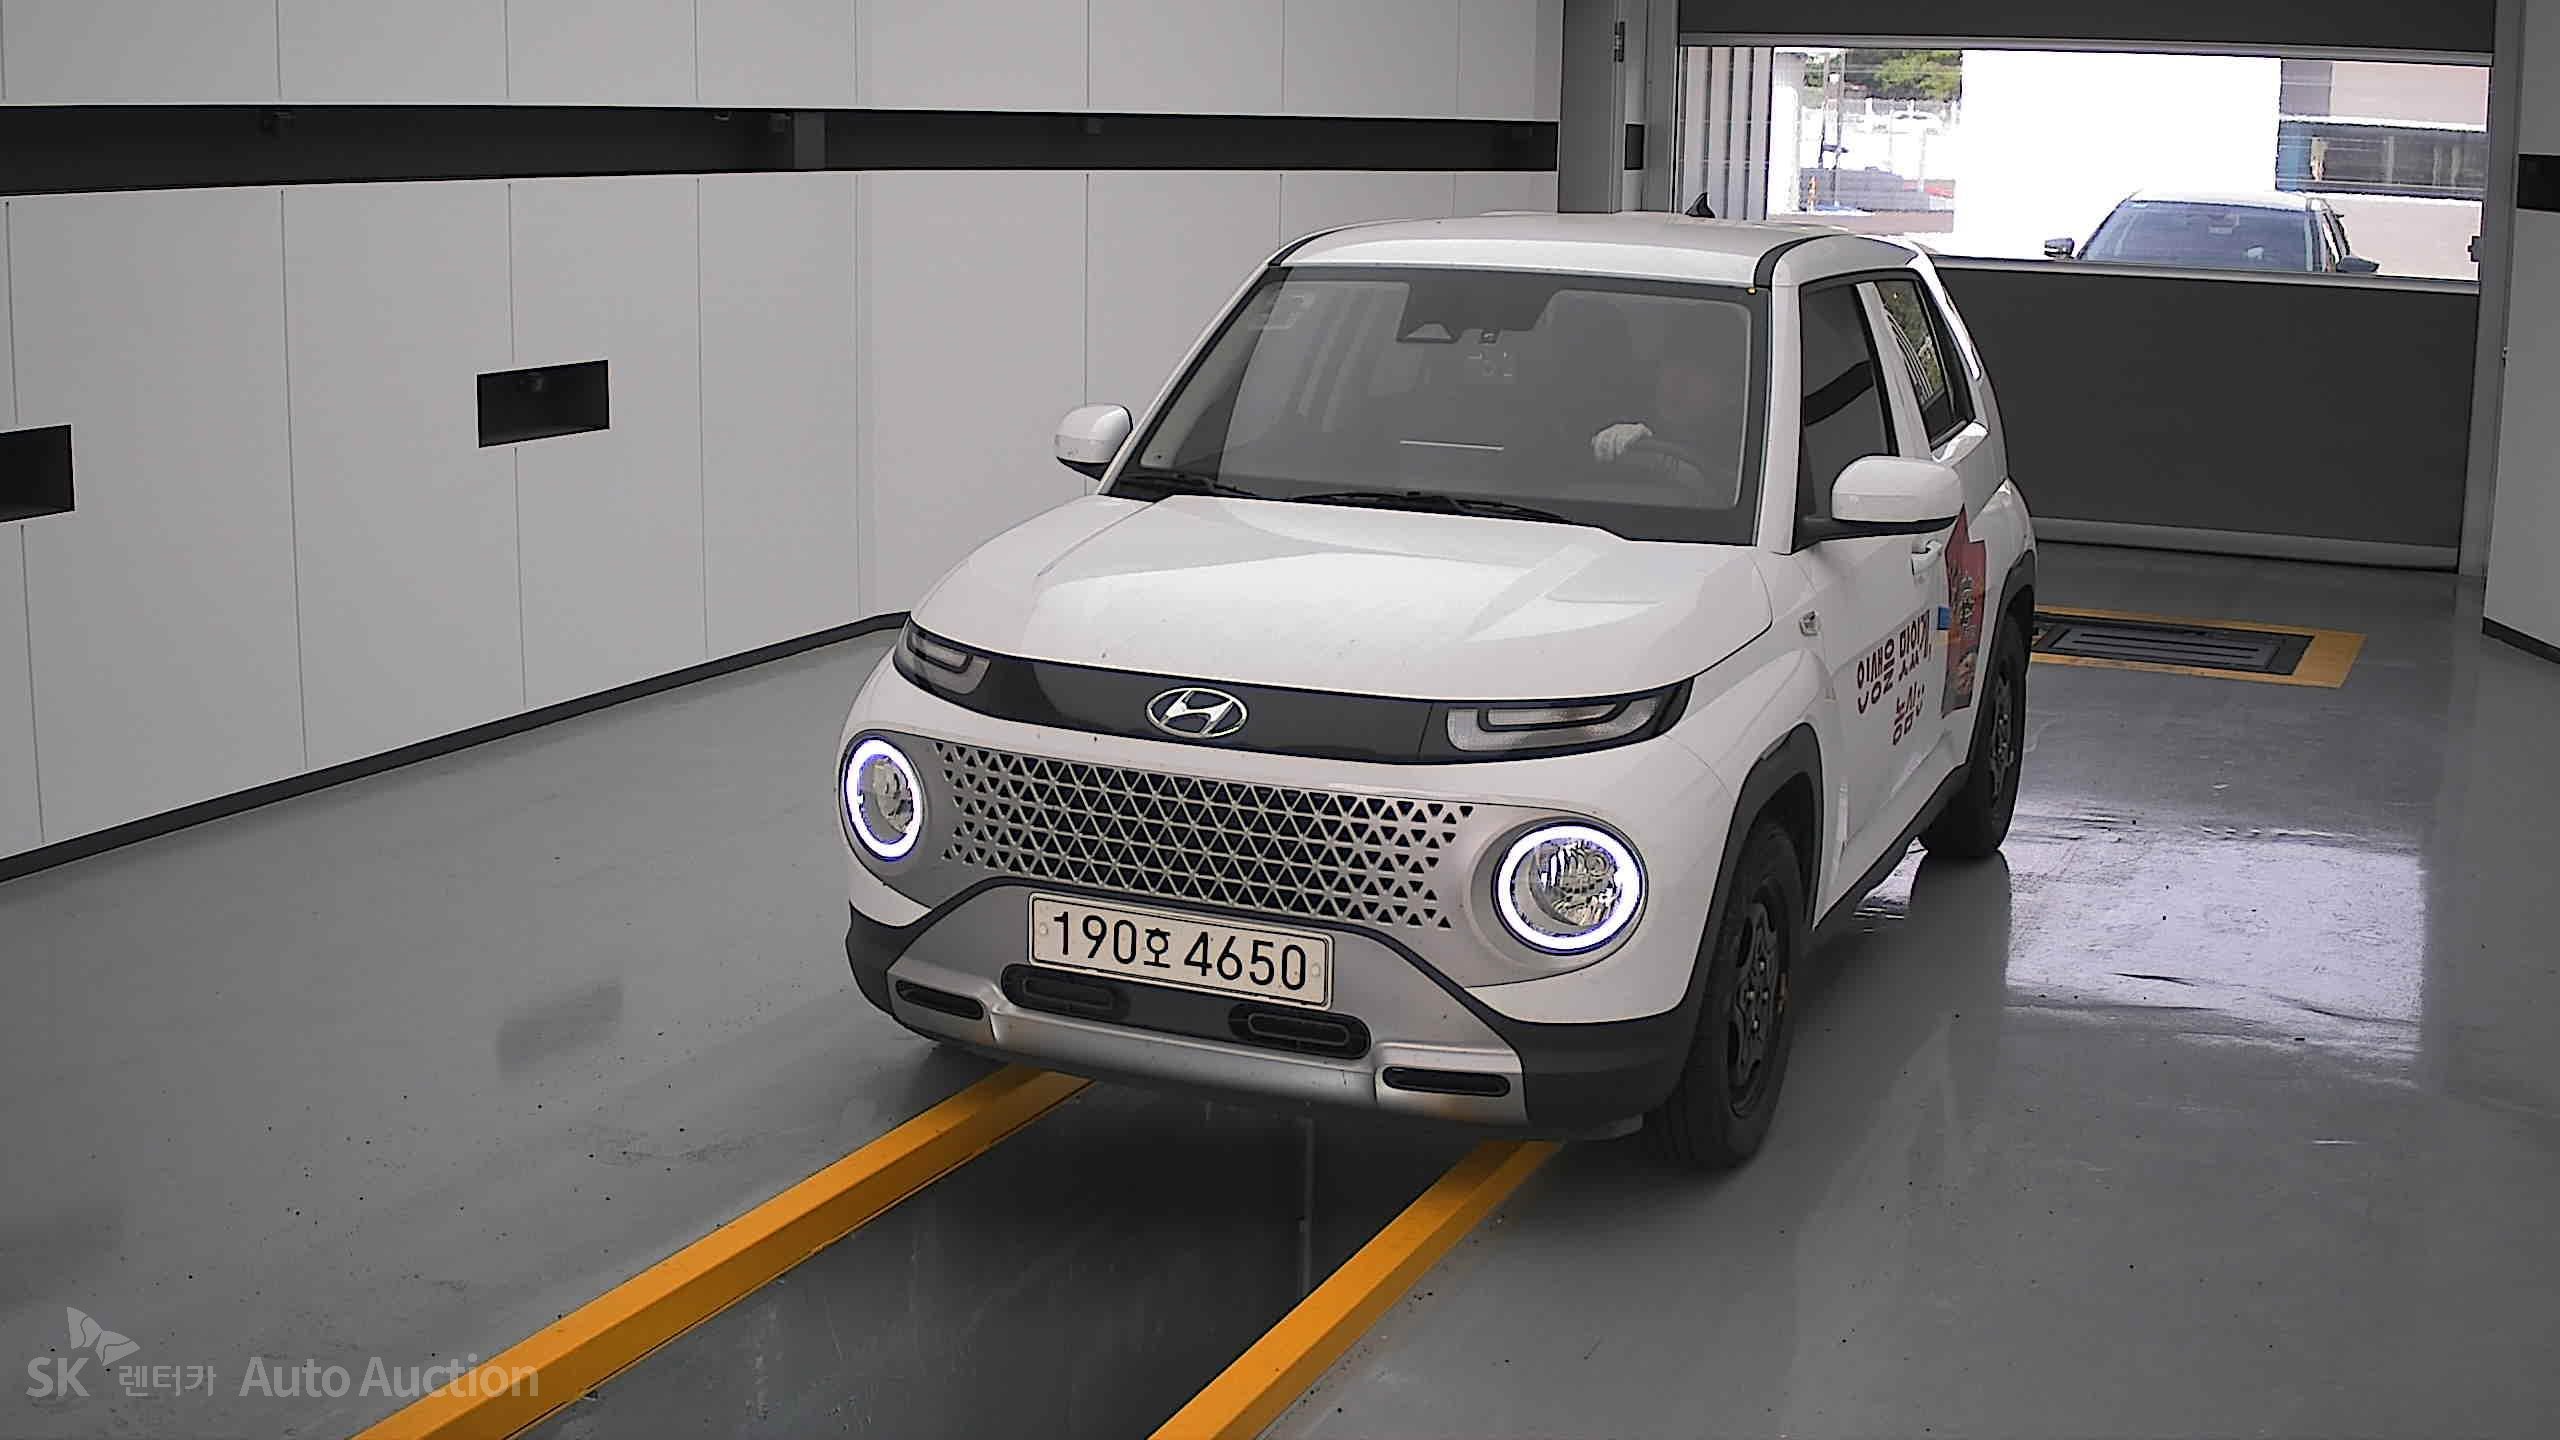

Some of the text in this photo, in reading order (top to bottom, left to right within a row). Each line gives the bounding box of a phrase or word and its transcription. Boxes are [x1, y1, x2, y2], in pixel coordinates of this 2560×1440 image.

[1856, 638, 1895, 714] 인생을
[1053, 911, 1306, 990] 190호 4650
